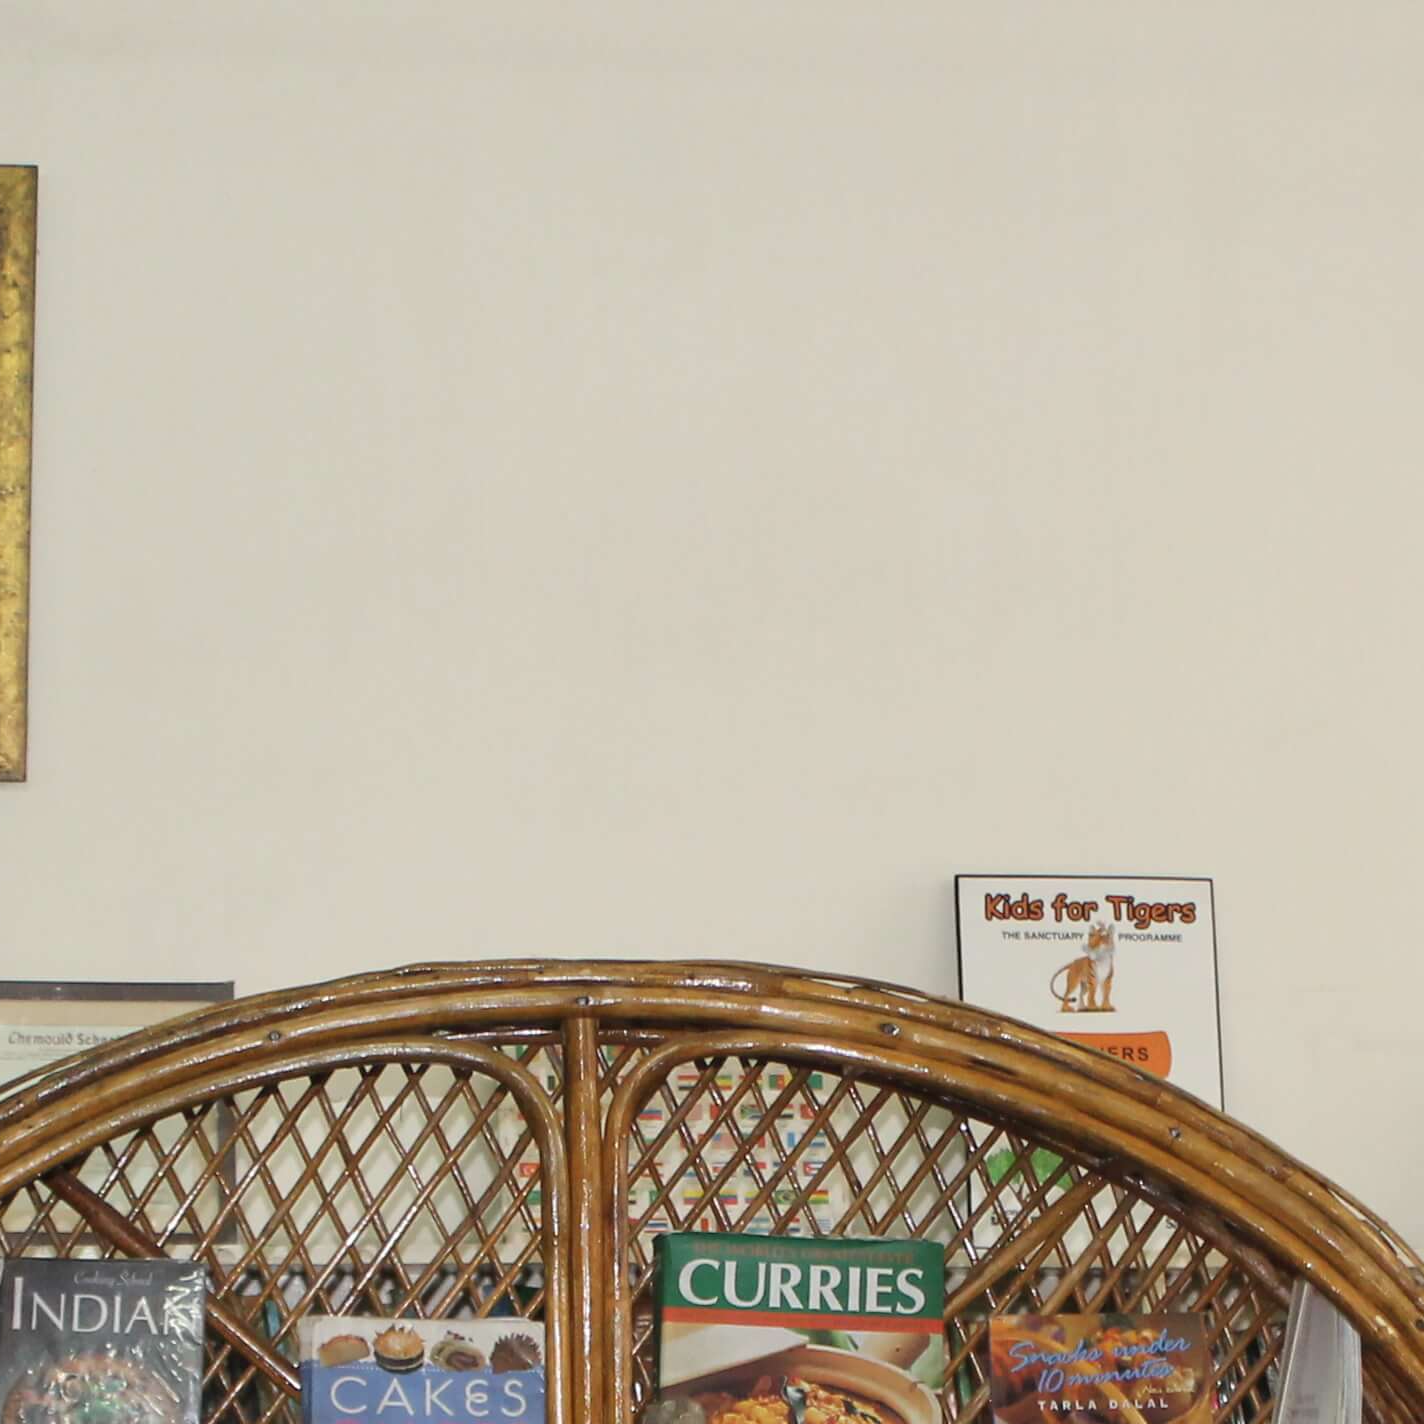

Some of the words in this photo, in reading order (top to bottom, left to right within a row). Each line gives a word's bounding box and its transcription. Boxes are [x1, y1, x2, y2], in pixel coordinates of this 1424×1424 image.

[984, 893, 1044, 922] Kids
[1051, 893, 1098, 922] for
[1104, 895, 1197, 929] Tigers
[1002, 930, 1021, 941] THE
[1024, 930, 1085, 942] SANCTUARY
[1117, 933, 1183, 943] PROGRAMME
[678, 1258, 926, 1315] CURRIES
[1008, 1338, 1103, 1373] Snacks
[1112, 1327, 1193, 1358] under
[330, 1375, 527, 1417] CAKES
[1037, 1367, 1065, 1394] 10
[1037, 1399, 1098, 1412] TARLA
[1108, 1397, 1170, 1410] DALAL
